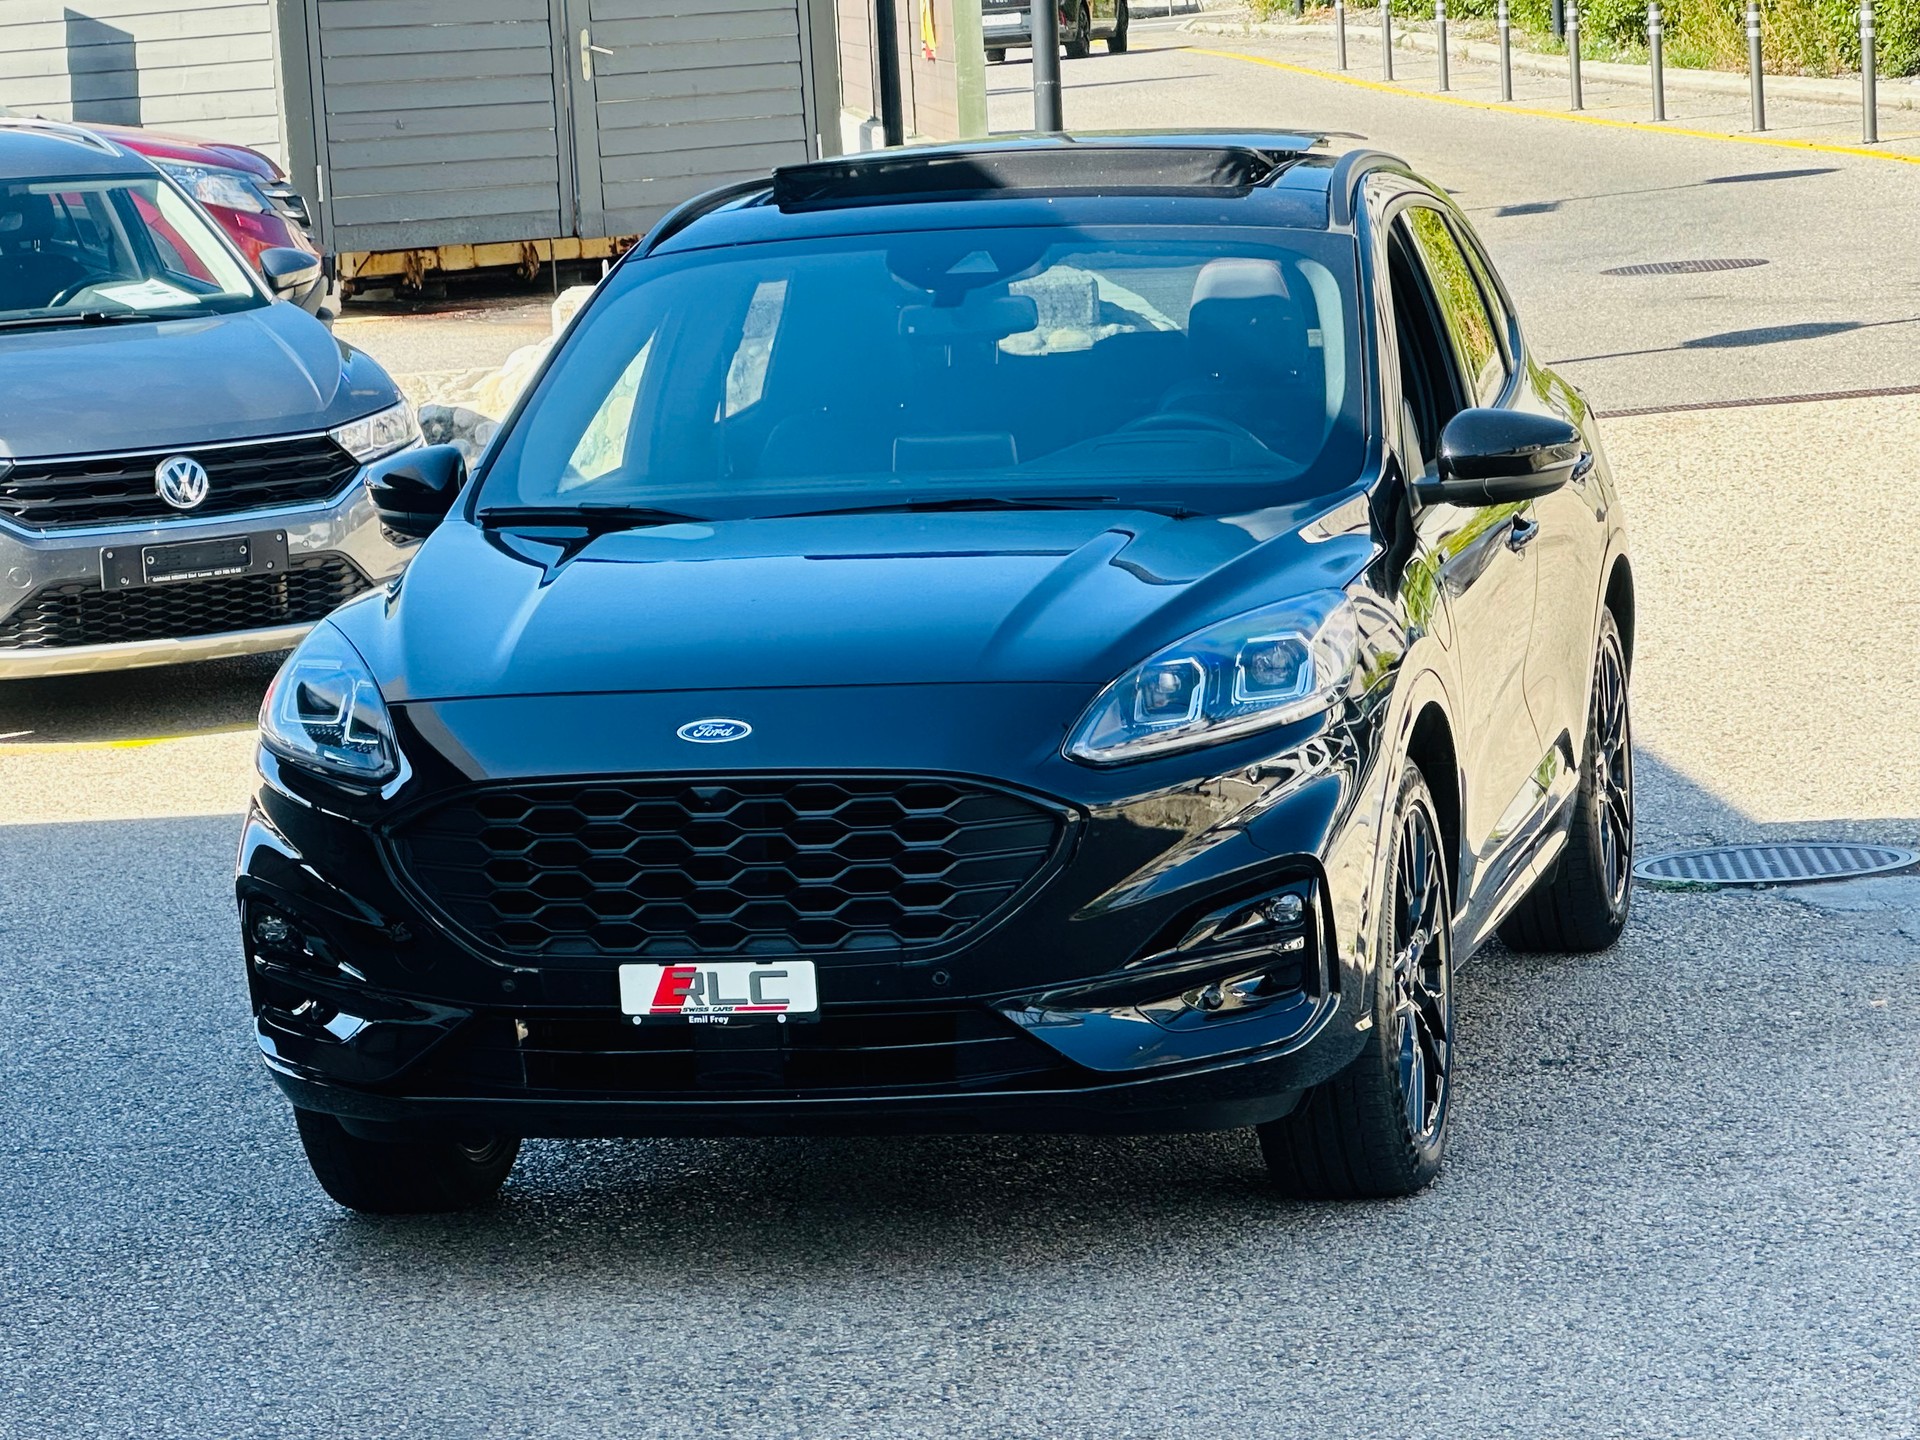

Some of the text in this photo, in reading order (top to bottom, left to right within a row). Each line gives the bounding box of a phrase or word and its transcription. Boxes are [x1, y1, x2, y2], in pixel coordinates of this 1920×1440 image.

[160, 456, 205, 505] VW
[692, 723, 735, 737] Ford
[688, 1015, 729, 1025] Emil Frey
